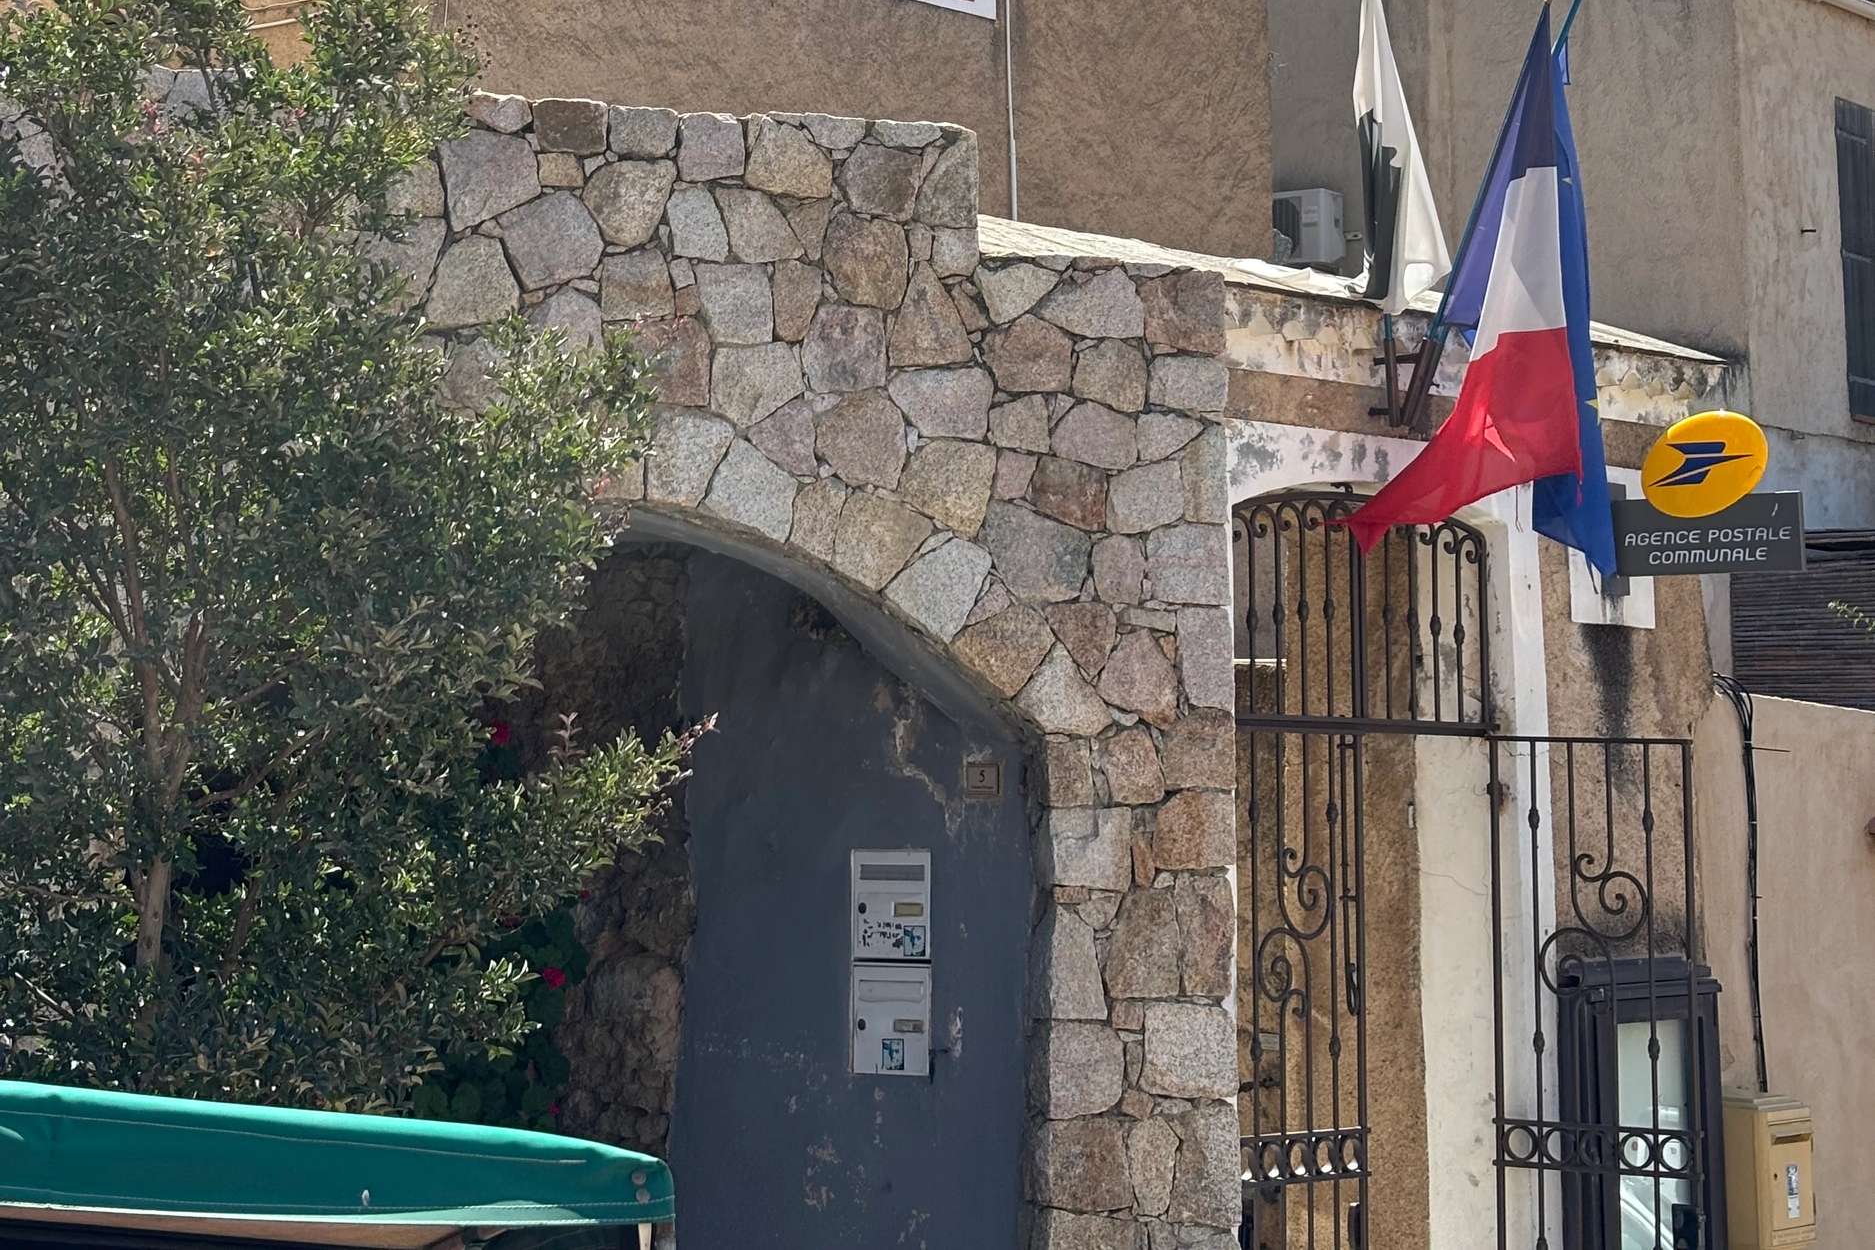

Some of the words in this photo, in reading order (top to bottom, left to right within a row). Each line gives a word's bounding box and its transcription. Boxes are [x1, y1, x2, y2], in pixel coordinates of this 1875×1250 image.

[1624, 530, 1701, 547] AGENCE
[1708, 526, 1792, 543] POSTALE
[1649, 547, 1768, 565] COMMUNALE
[979, 769, 986, 783] 5
